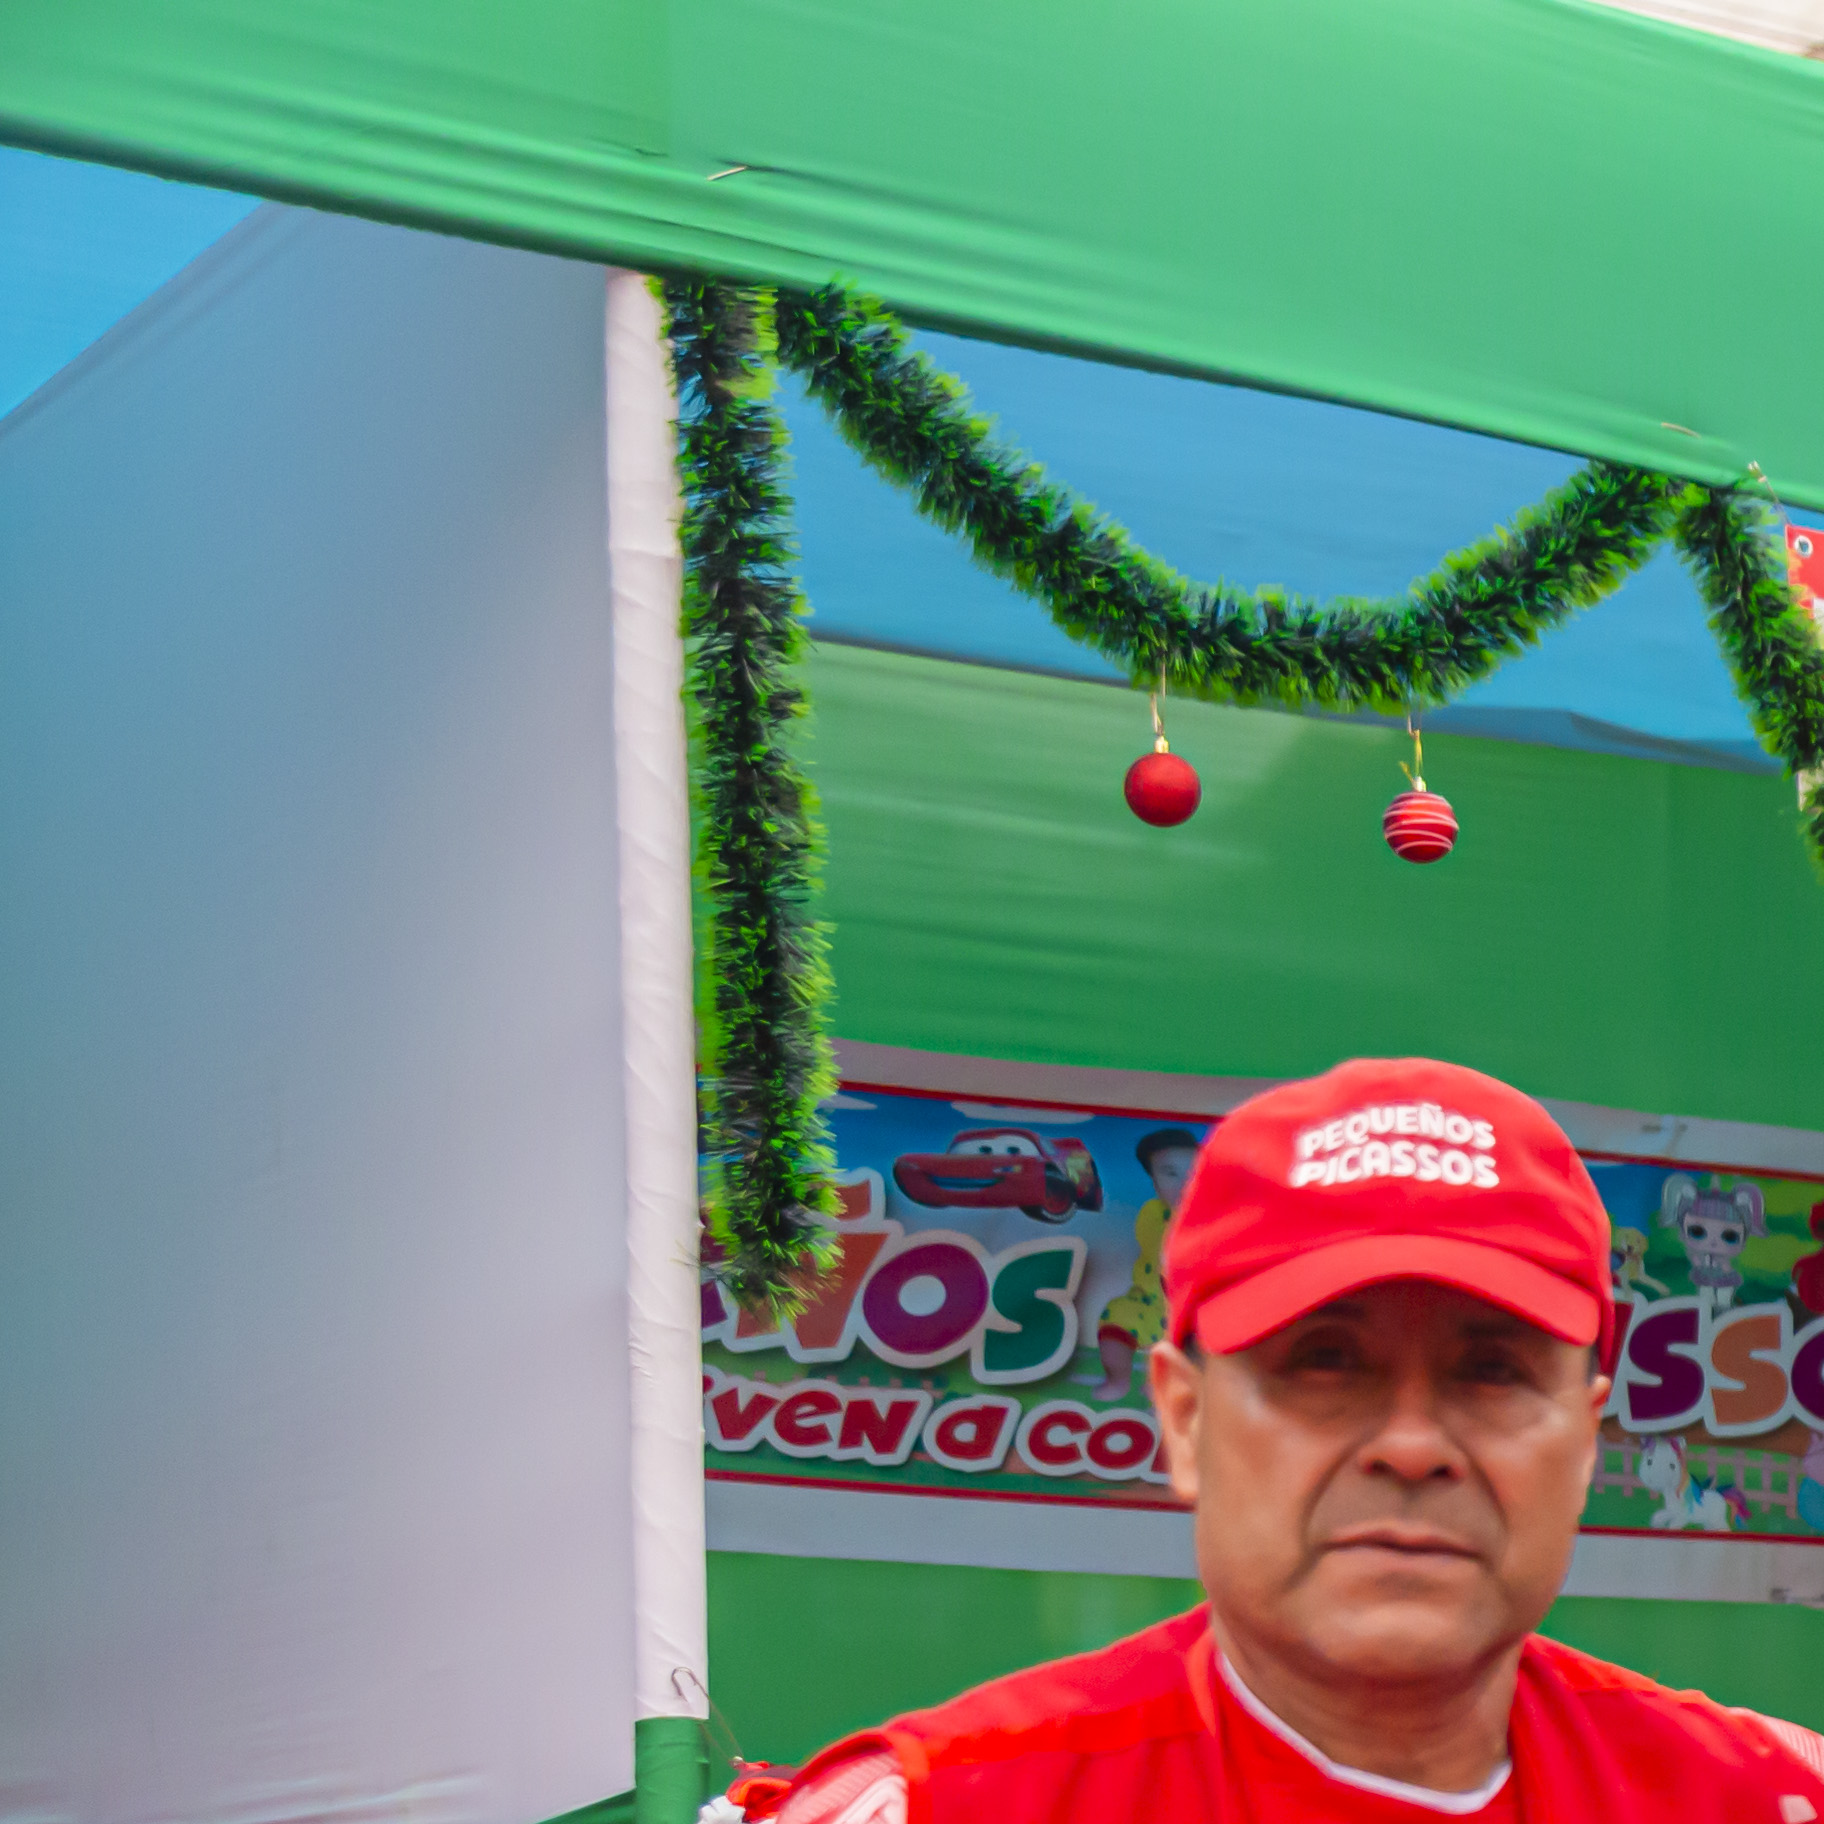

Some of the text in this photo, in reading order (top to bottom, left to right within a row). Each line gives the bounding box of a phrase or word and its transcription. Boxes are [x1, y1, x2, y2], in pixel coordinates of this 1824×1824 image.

[1301, 1101, 1497, 1157] PEQUEÑOS
[1290, 1139, 1500, 1189] PICASSOS
[935, 1405, 1009, 1459] a
